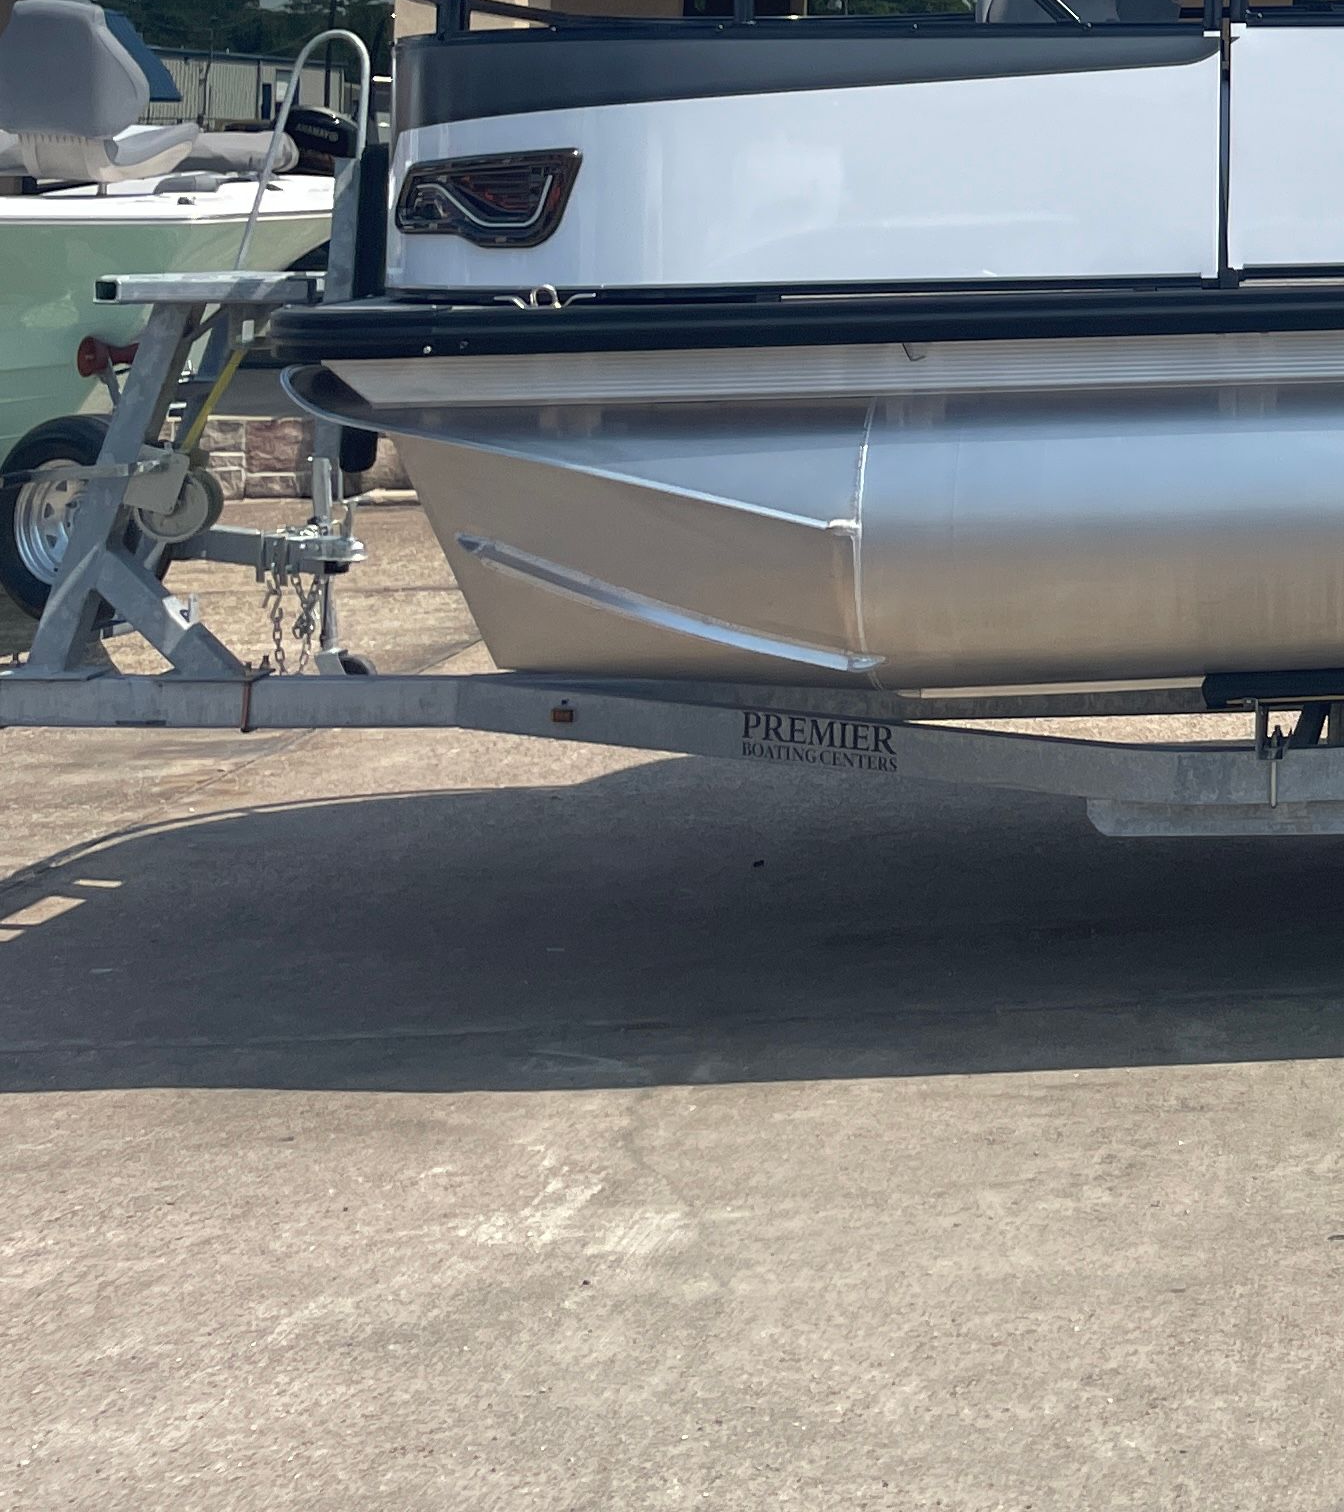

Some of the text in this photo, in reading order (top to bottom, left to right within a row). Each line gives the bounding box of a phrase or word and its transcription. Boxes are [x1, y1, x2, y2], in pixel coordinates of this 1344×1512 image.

[742, 711, 897, 755] PREMIER
[742, 741, 899, 772] BOATING CENTERS
